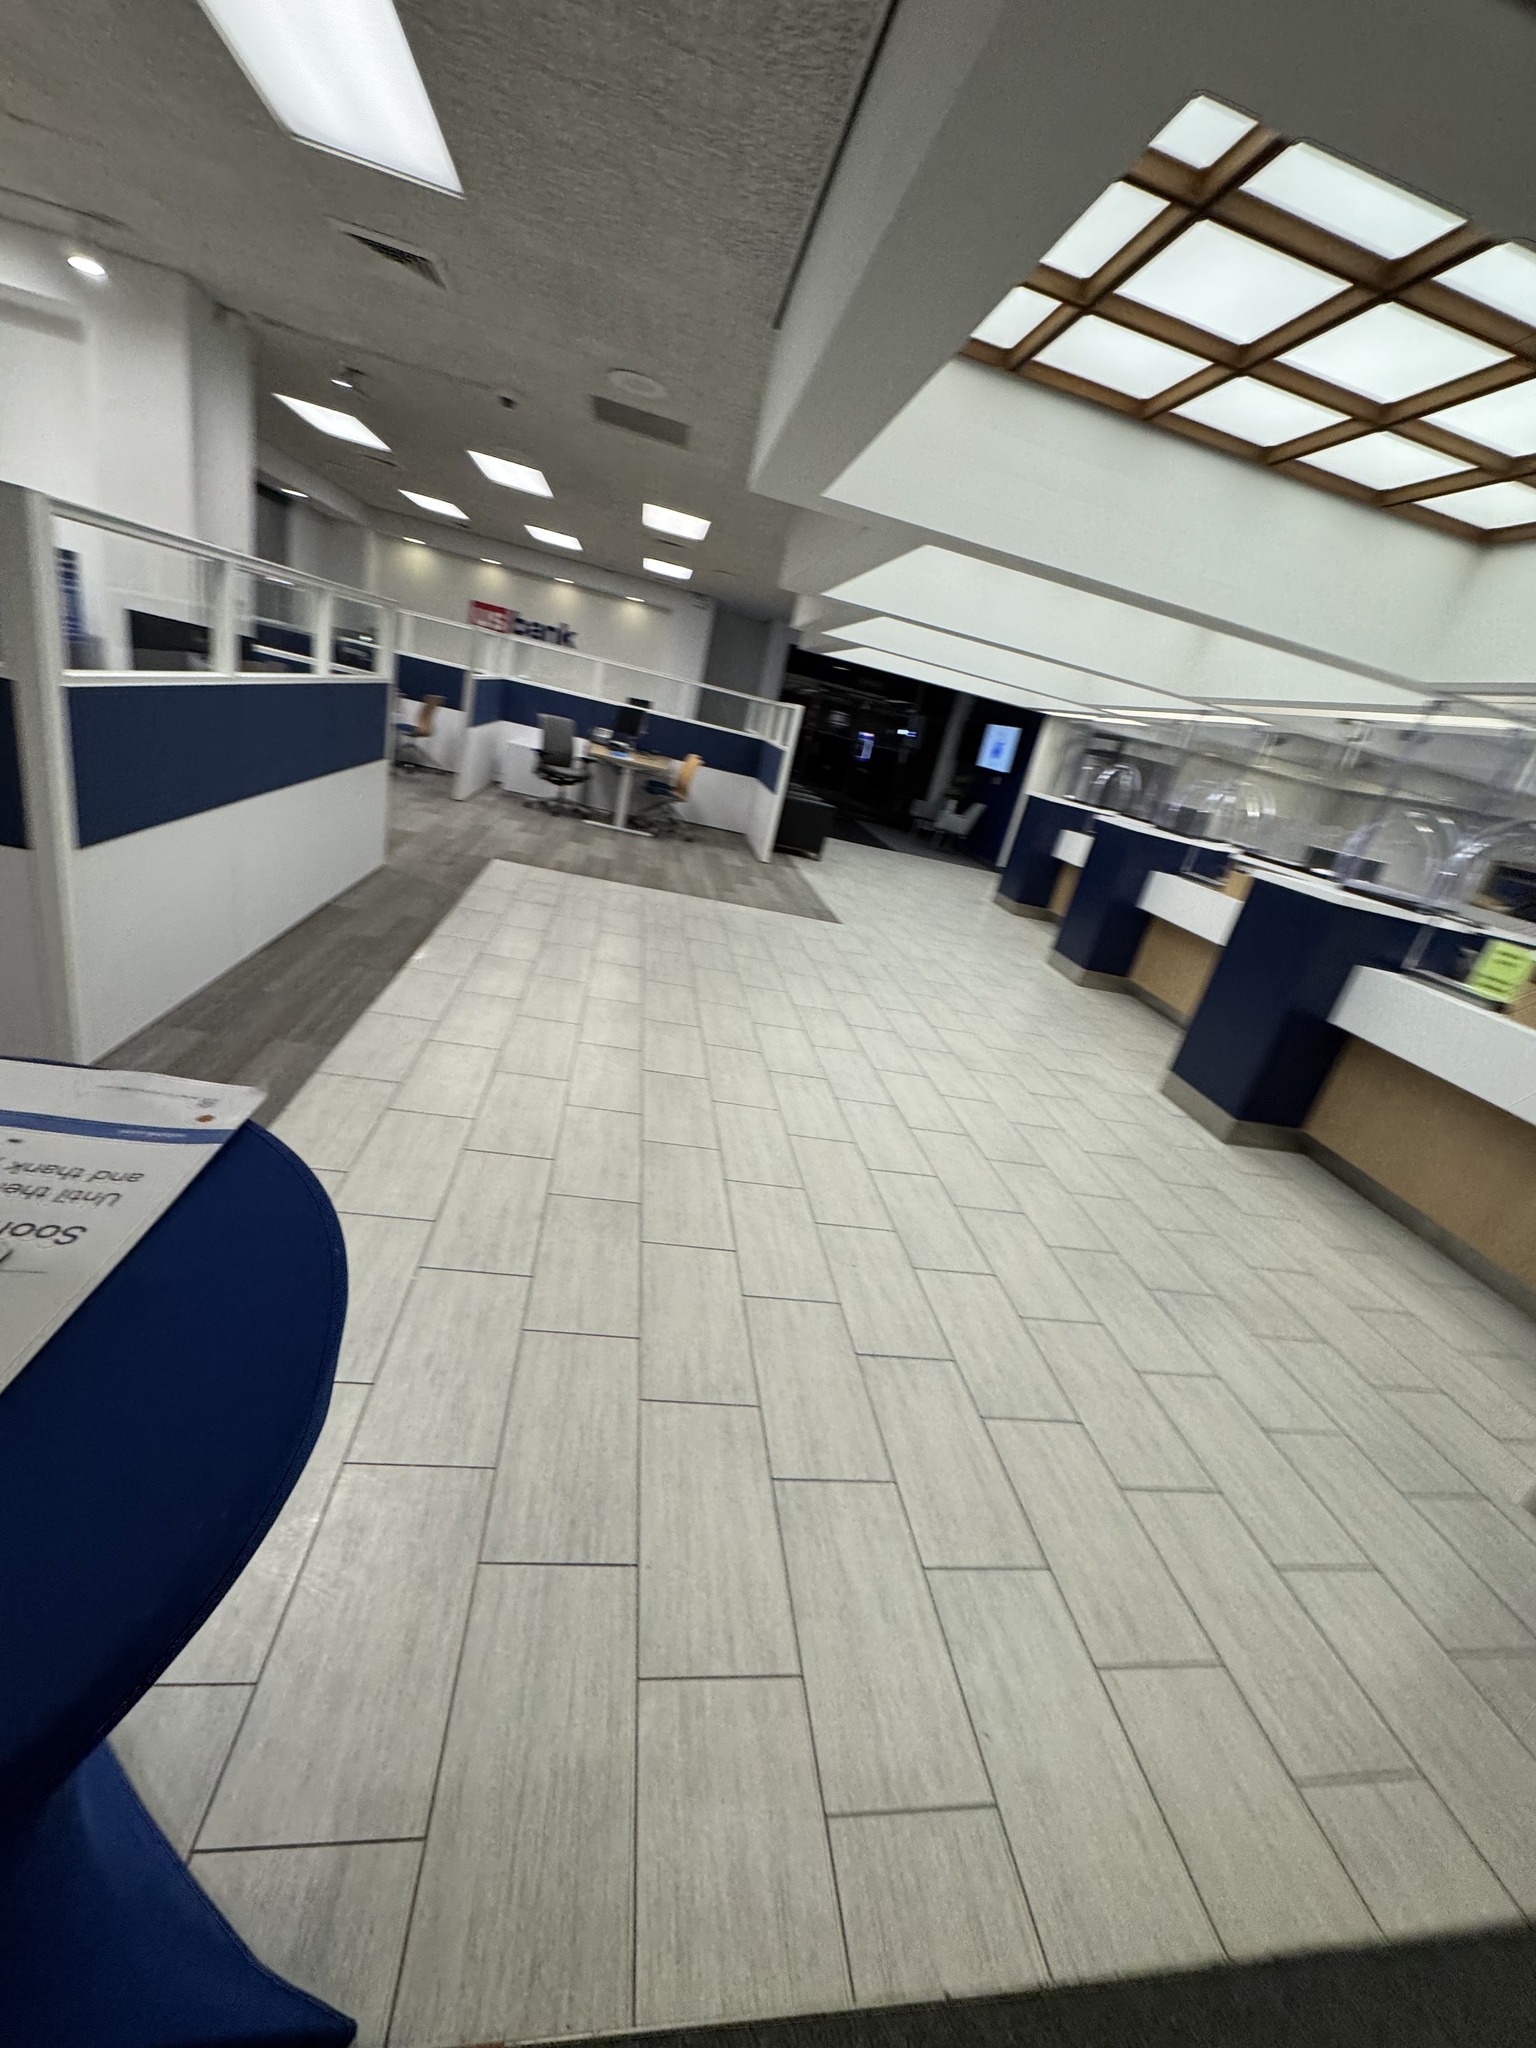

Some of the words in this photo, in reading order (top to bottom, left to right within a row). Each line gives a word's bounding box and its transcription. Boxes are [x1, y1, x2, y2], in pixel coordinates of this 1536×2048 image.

[4, 1161, 85, 1180] thank
[85, 1170, 145, 1183] and
[0, 1183, 51, 1199] the
[52, 1189, 122, 1207] Until
